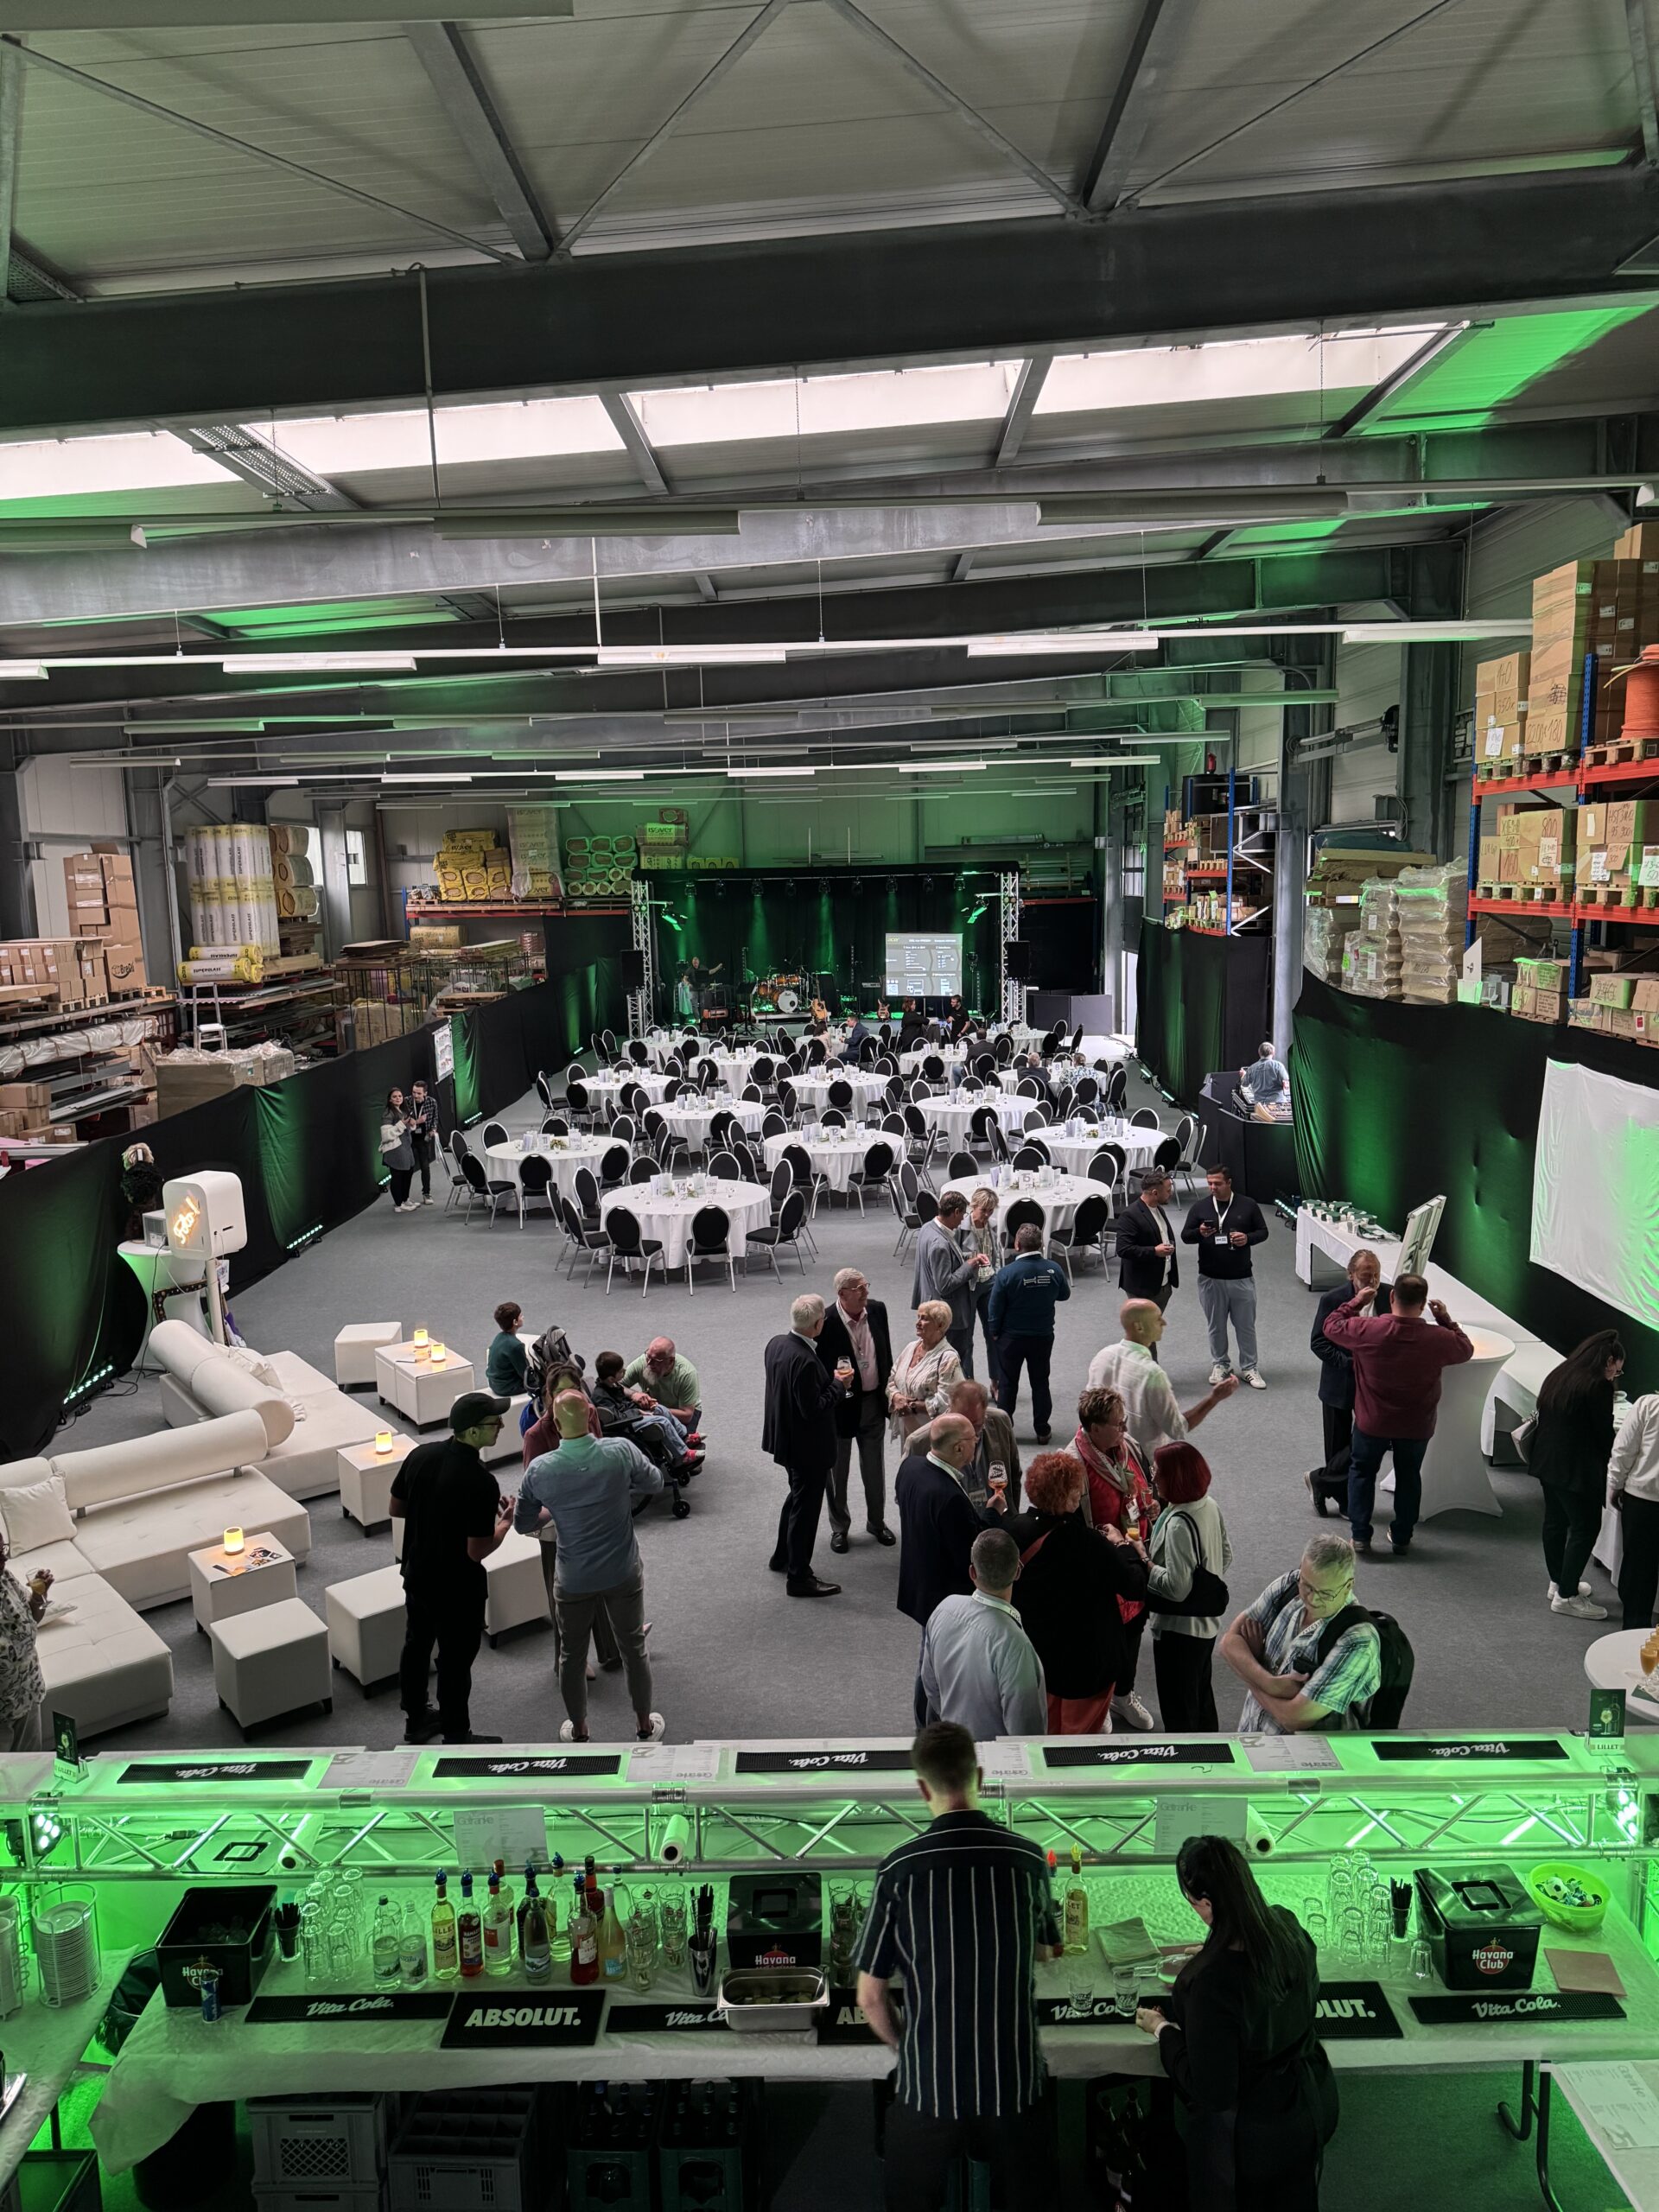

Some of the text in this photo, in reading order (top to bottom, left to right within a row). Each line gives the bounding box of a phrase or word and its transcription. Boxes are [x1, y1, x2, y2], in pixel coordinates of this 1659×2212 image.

[1140, 1745, 1179, 1758] Vita
[1470, 1742, 1510, 1754] Vita
[531, 1758, 568, 1770] Vita
[831, 1752, 868, 1764] Vita
[219, 1763, 257, 1774] Vita
[754, 1955, 796, 1965] Havana
[1472, 1949, 1514, 1960] Havana
[1479, 1960, 1503, 1969] Club
[182, 1967, 224, 1977] Havaa
[306, 2002, 346, 2016] Vita
[1471, 1999, 1515, 2018] Vita
[665, 2012, 705, 2028] Vita
